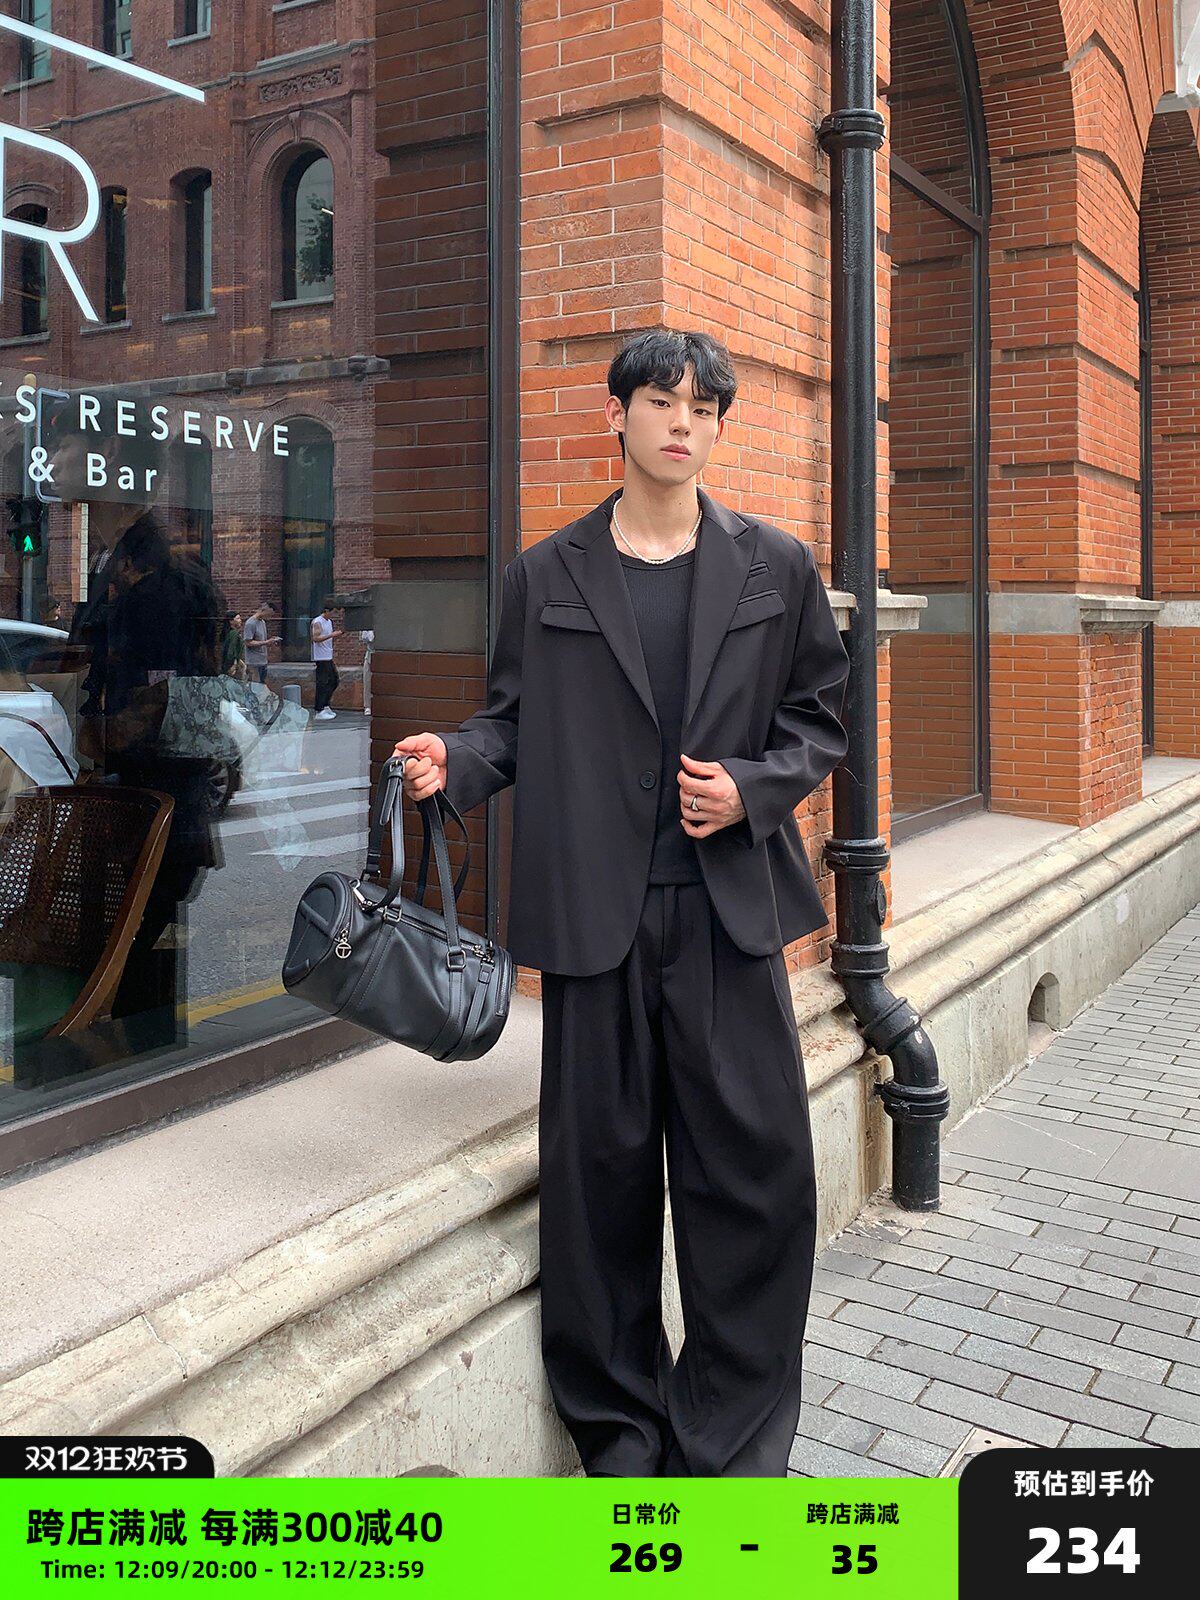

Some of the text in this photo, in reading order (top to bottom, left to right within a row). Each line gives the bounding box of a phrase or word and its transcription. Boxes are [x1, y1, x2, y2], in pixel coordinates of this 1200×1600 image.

[0, 381, 290, 457] S RESERVE
[28, 445, 158, 492] & Bar
